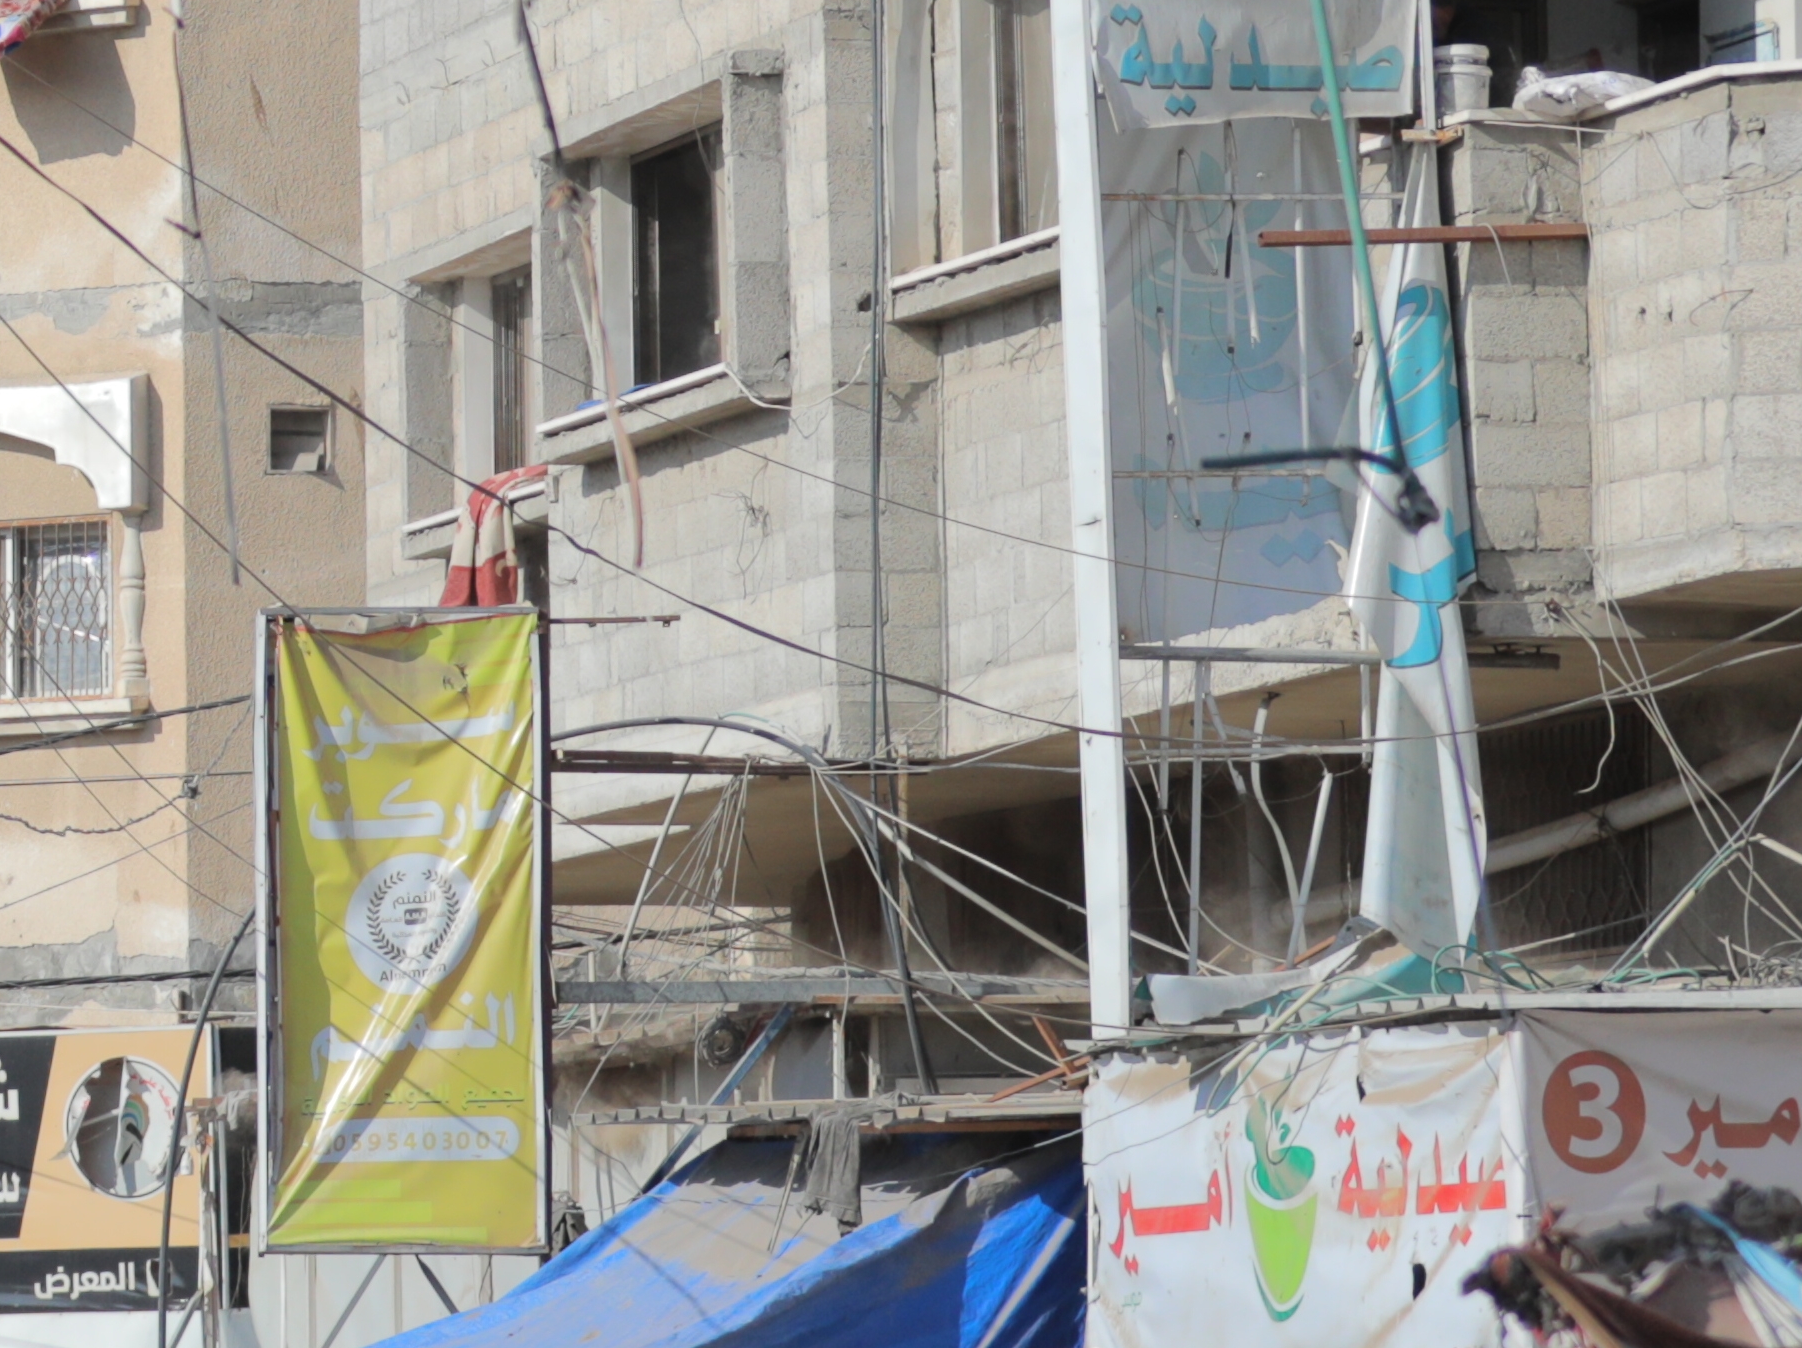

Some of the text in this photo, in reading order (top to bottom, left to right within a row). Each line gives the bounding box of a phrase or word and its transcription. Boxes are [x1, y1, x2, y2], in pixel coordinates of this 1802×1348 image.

[1110, 3, 1405, 119] صيدلية
[304, 696, 516, 761] سوبر
[307, 775, 515, 848] ماركت
[309, 990, 517, 1082] النمنم
[1568, 1063, 1802, 1180] مير 3
[1107, 1121, 1234, 1277] أمير
[33, 1261, 136, 1301] المعرض
